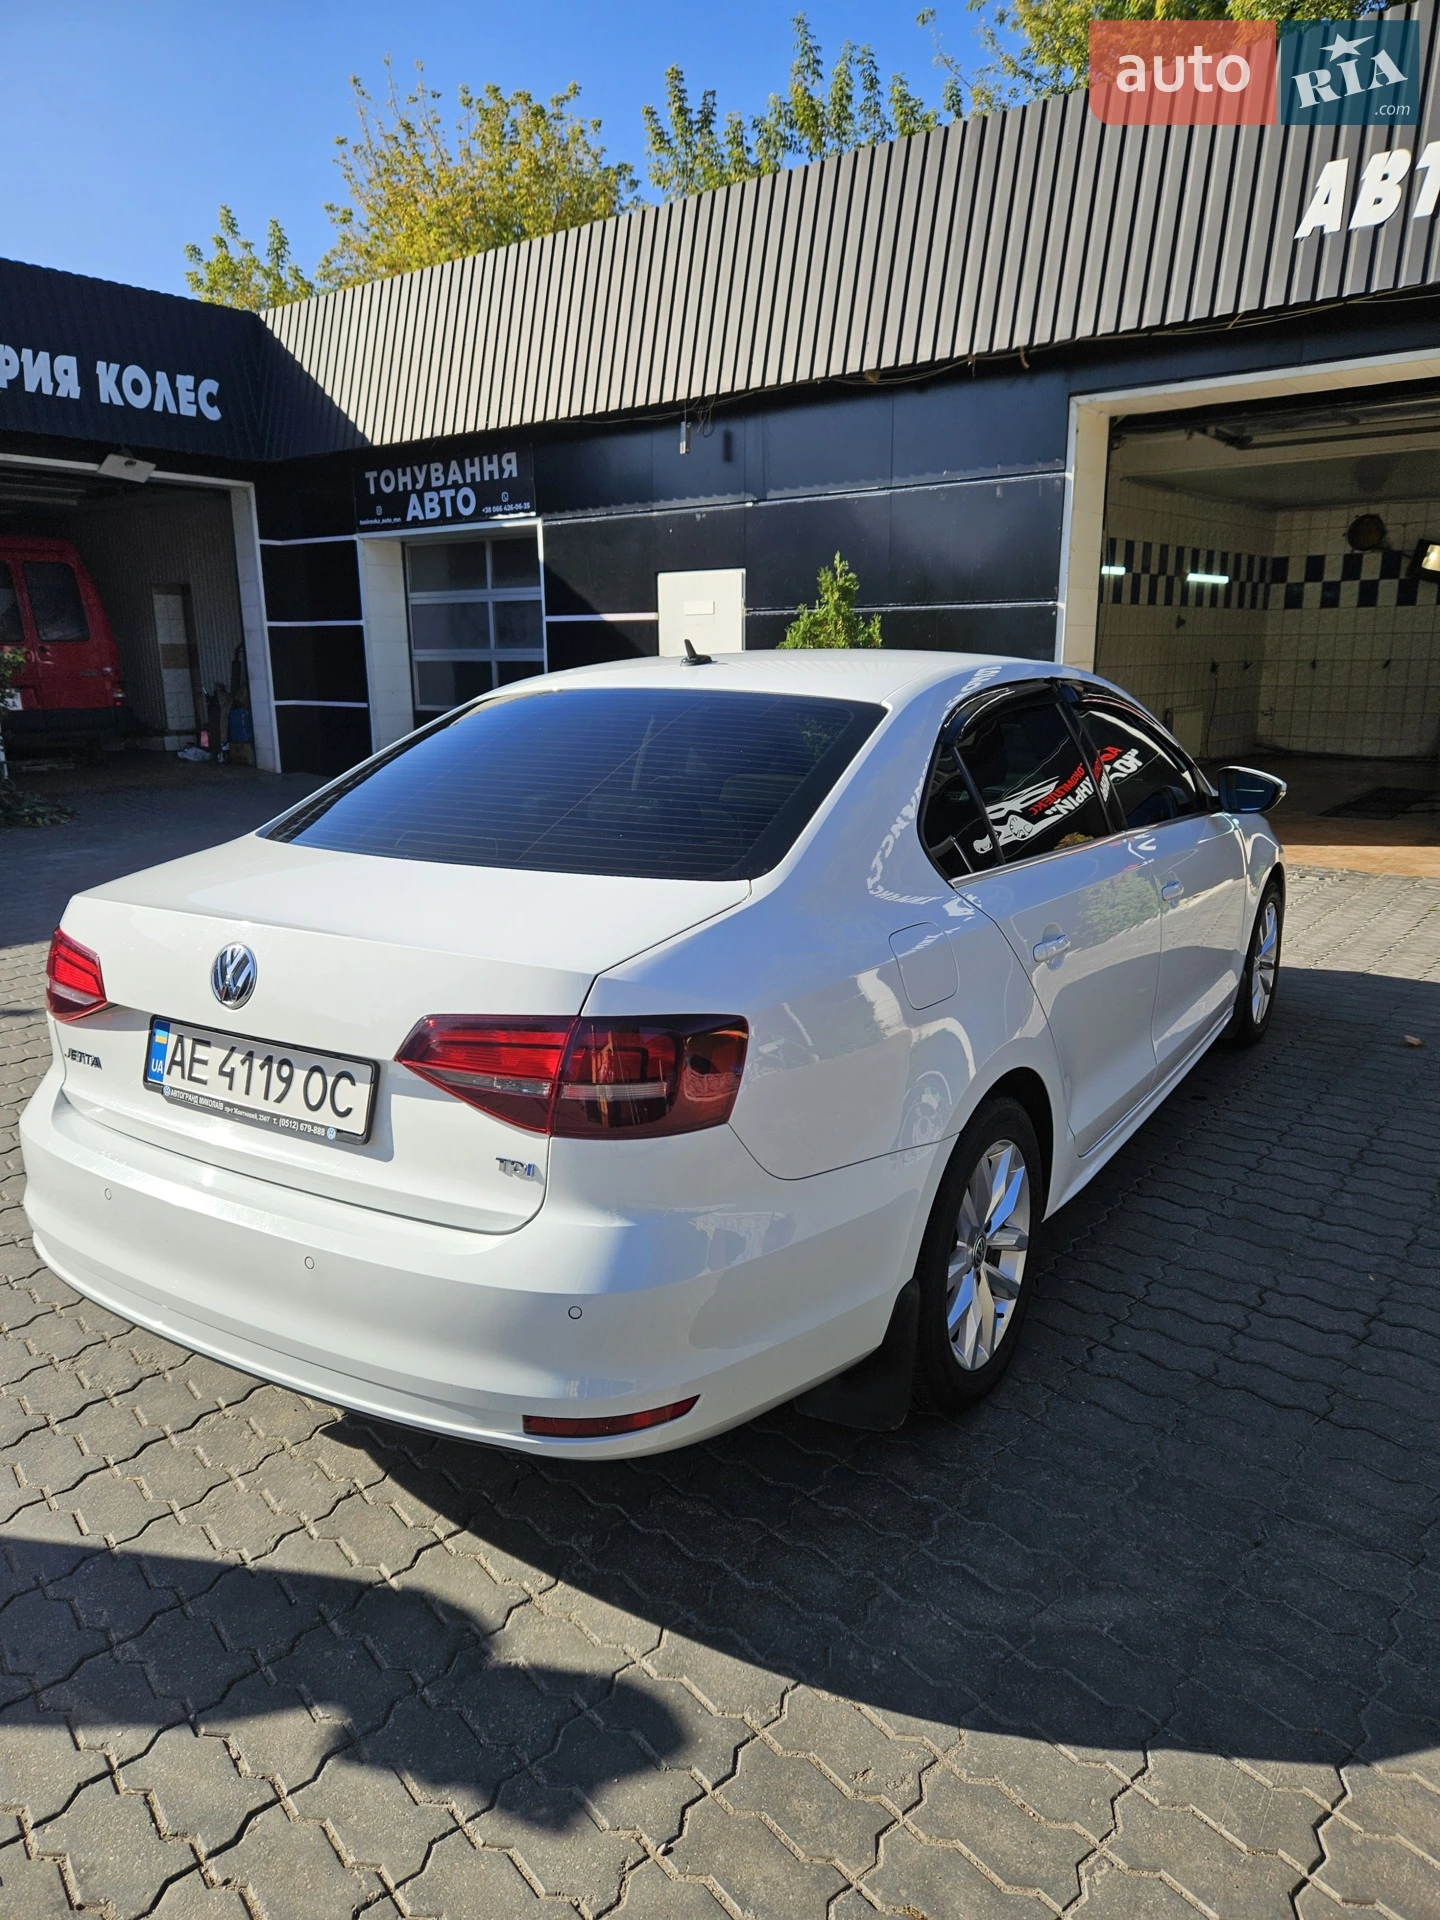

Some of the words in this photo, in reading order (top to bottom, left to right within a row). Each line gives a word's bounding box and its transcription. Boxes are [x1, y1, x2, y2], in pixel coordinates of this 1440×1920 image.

[96, 360, 222, 421] КОЛЕС
[365, 452, 518, 495] ТОНУВАННЯ
[406, 486, 476, 521] АВТО
[64, 1047, 103, 1070] JETTA
[151, 1058, 164, 1075] UA
[166, 1033, 211, 1086] AE
[217, 1045, 294, 1104] 4119
[303, 1065, 356, 1118] OC
[170, 1089, 198, 1105] АВТОГРАНД
[199, 1096, 224, 1110] МИКОЛАЇВ
[279, 1118, 299, 1131] (0512)
[300, 1123, 326, 1136] 679-888
[495, 1157, 534, 1177] TDI
